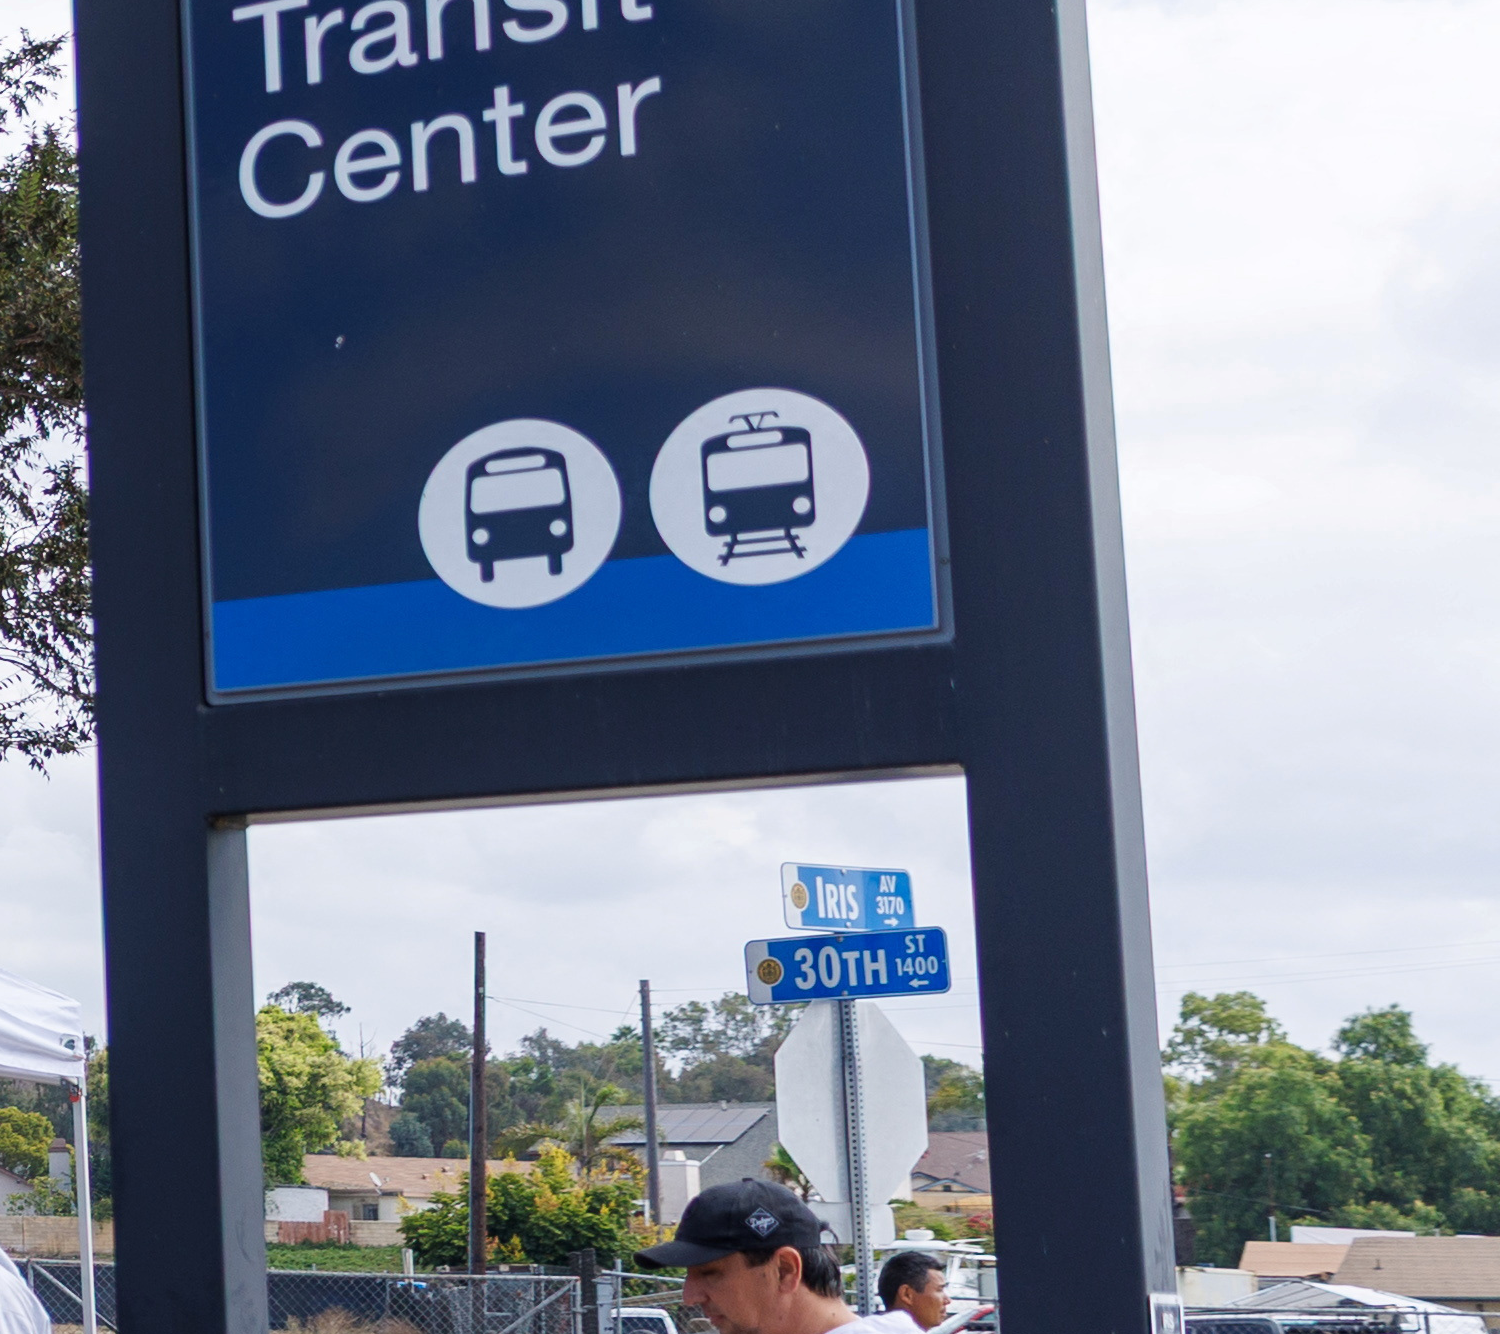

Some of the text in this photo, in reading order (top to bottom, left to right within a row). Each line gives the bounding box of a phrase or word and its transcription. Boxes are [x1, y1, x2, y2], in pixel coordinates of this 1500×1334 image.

[237, 76, 662, 219] Center
[879, 874, 897, 893] AV
[815, 875, 860, 921] IRIS
[876, 896, 905, 915] 3170
[904, 934, 926, 954] ST
[794, 945, 888, 990] 30TH
[895, 955, 939, 976] 1400
